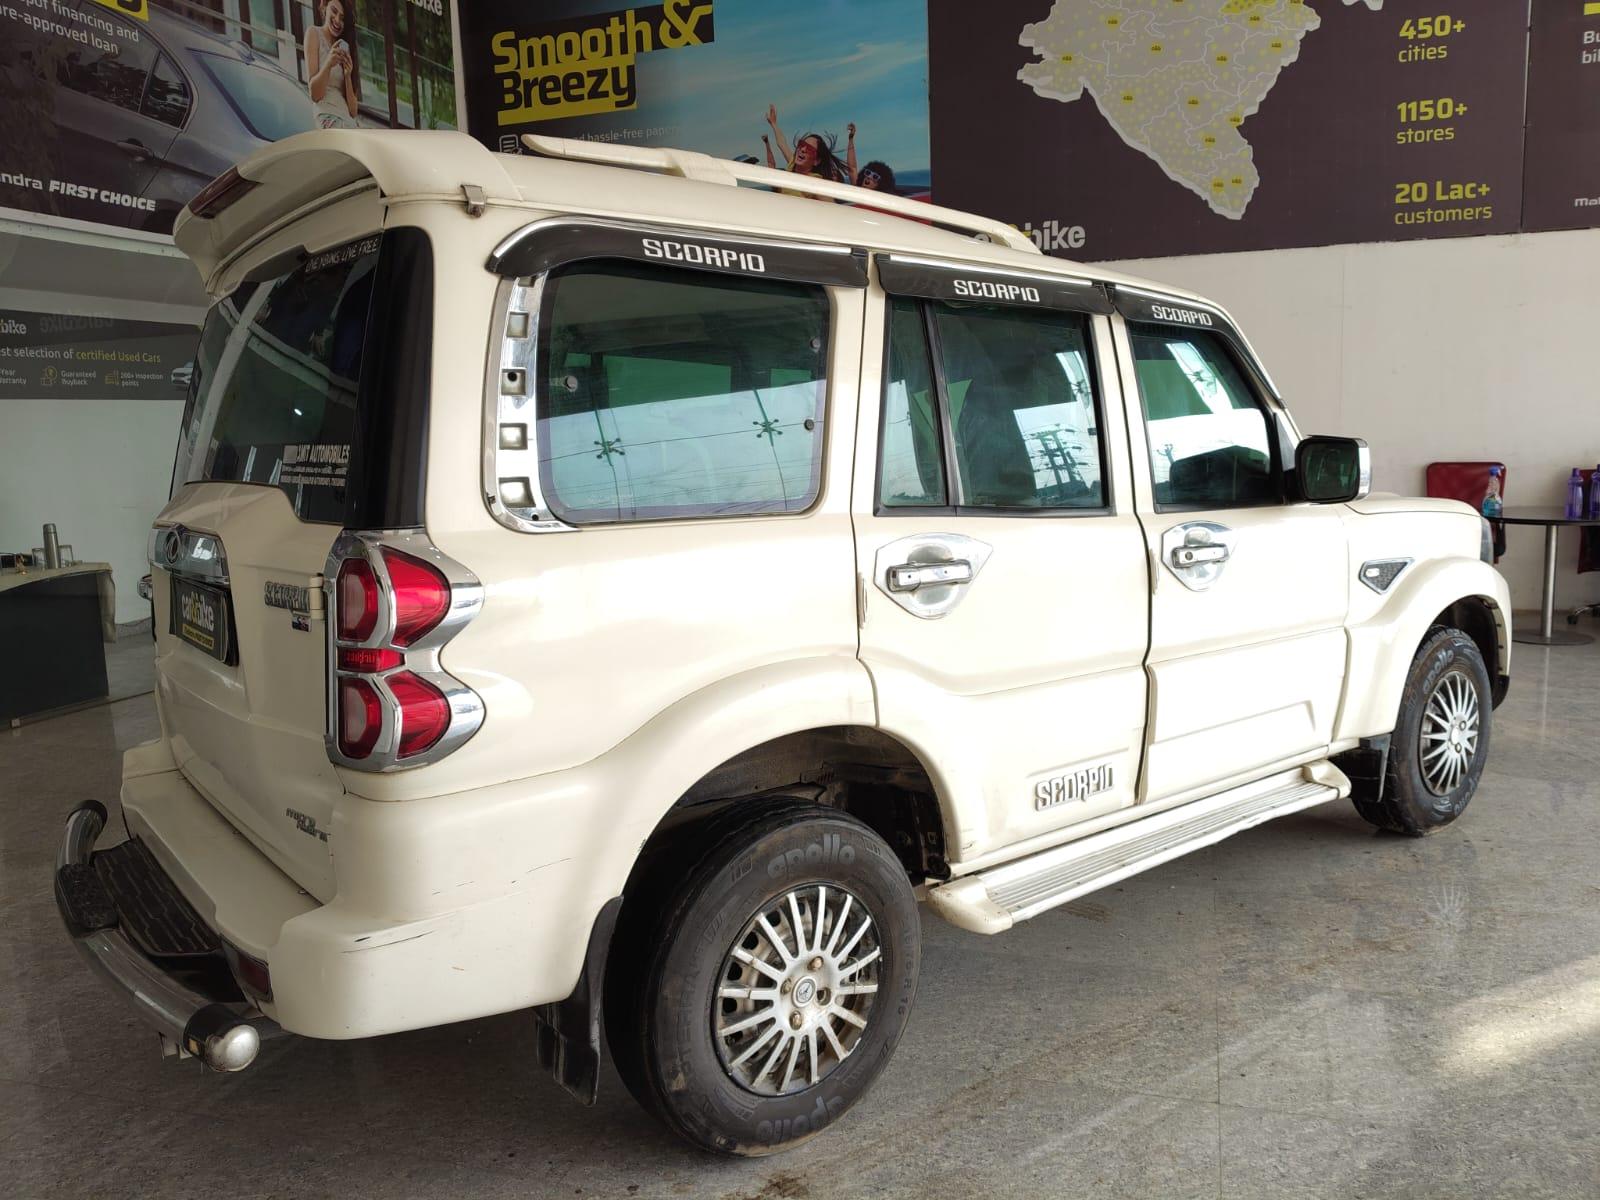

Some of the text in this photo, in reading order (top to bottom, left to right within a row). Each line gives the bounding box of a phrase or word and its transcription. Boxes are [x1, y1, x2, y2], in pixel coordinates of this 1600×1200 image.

[52, 0, 114, 36] financing
[116, 26, 139, 42] and
[1399, 15, 1466, 40] 450+
[91, 33, 118, 54] loan
[492, 0, 713, 74] Smooth &
[1398, 44, 1448, 63] cities
[499, 64, 637, 112] Breezy
[1397, 98, 1468, 122] 1150+
[1396, 127, 1455, 145] stores
[49, 180, 98, 200] FIRST
[100, 190, 156, 211] CHOICE
[1395, 180, 1491, 204] 20 Lac+
[1394, 205, 1493, 225] customers
[642, 238, 765, 273] SCORPIO
[953, 280, 1040, 303] SCORPIO
[1151, 305, 1213, 326] SCORPIO
[13, 346, 61, 359] selection
[63, 348, 74, 359] of
[767, 832, 856, 881] apollo
